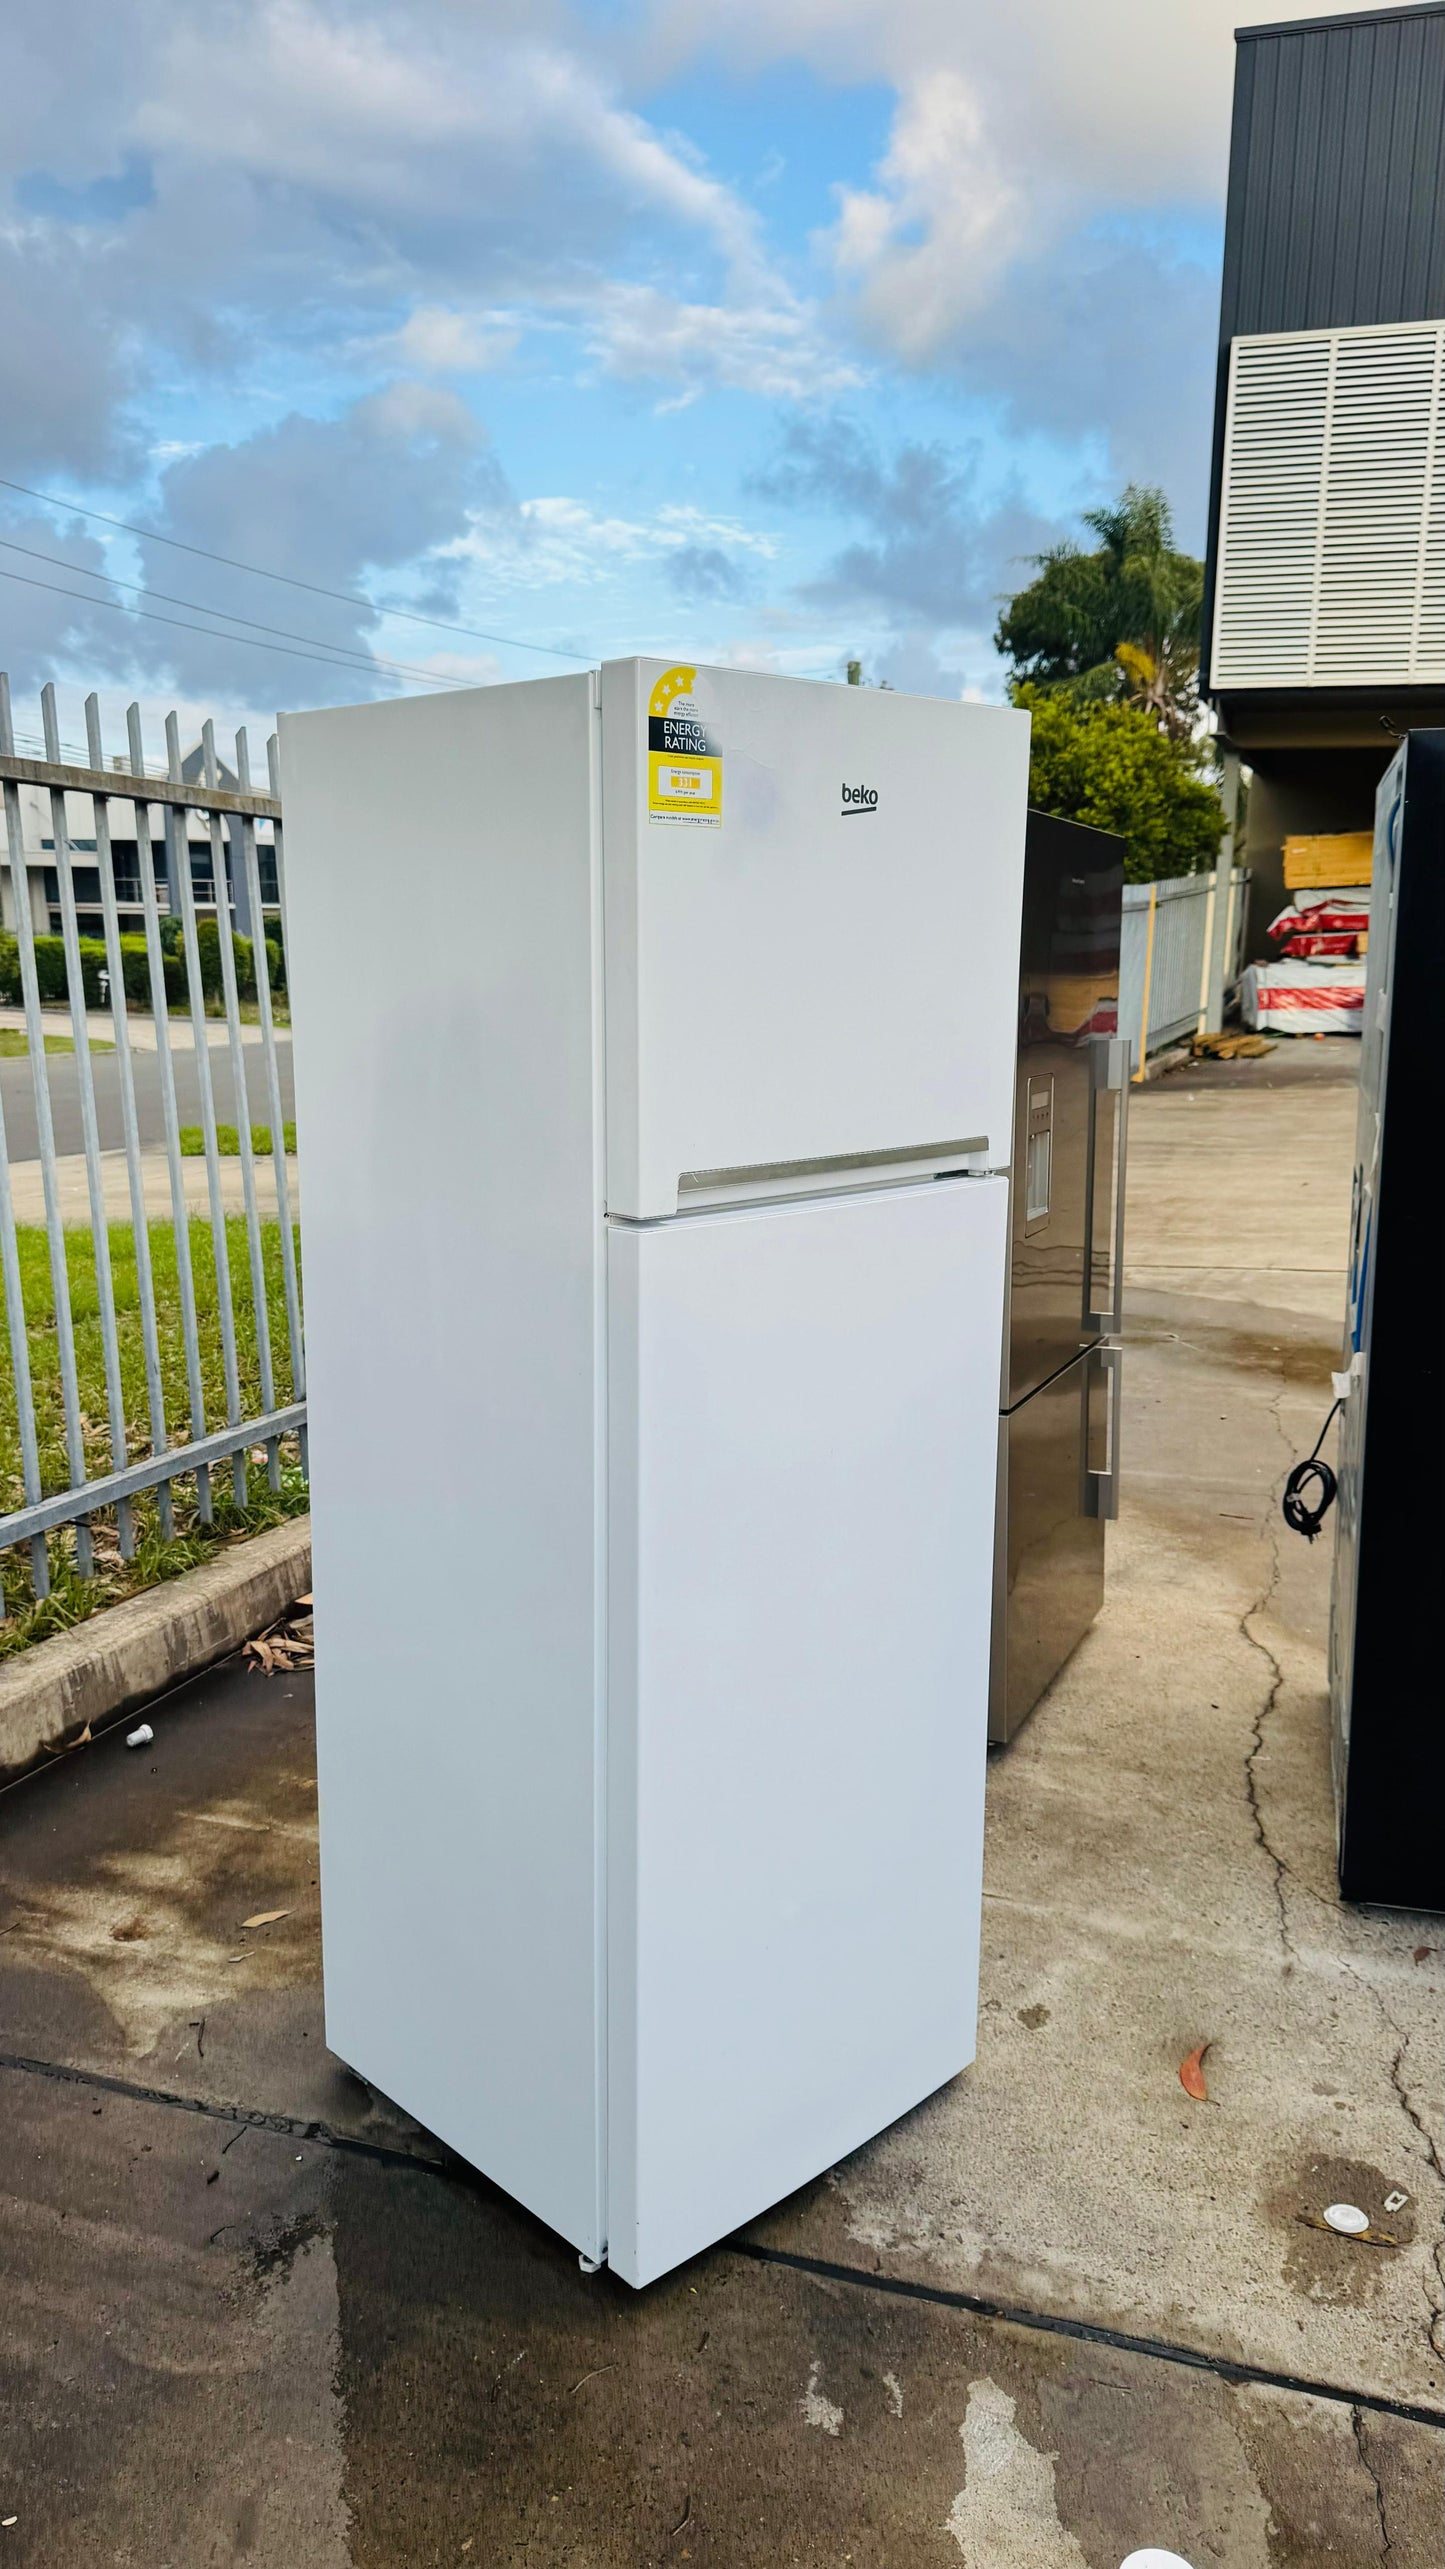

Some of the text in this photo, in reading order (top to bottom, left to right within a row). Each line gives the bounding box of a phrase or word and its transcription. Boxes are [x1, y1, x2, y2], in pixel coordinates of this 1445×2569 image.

[663, 720, 707, 738] ENERGY
[664, 735, 706, 752] RATING
[841, 782, 879, 805] beko
